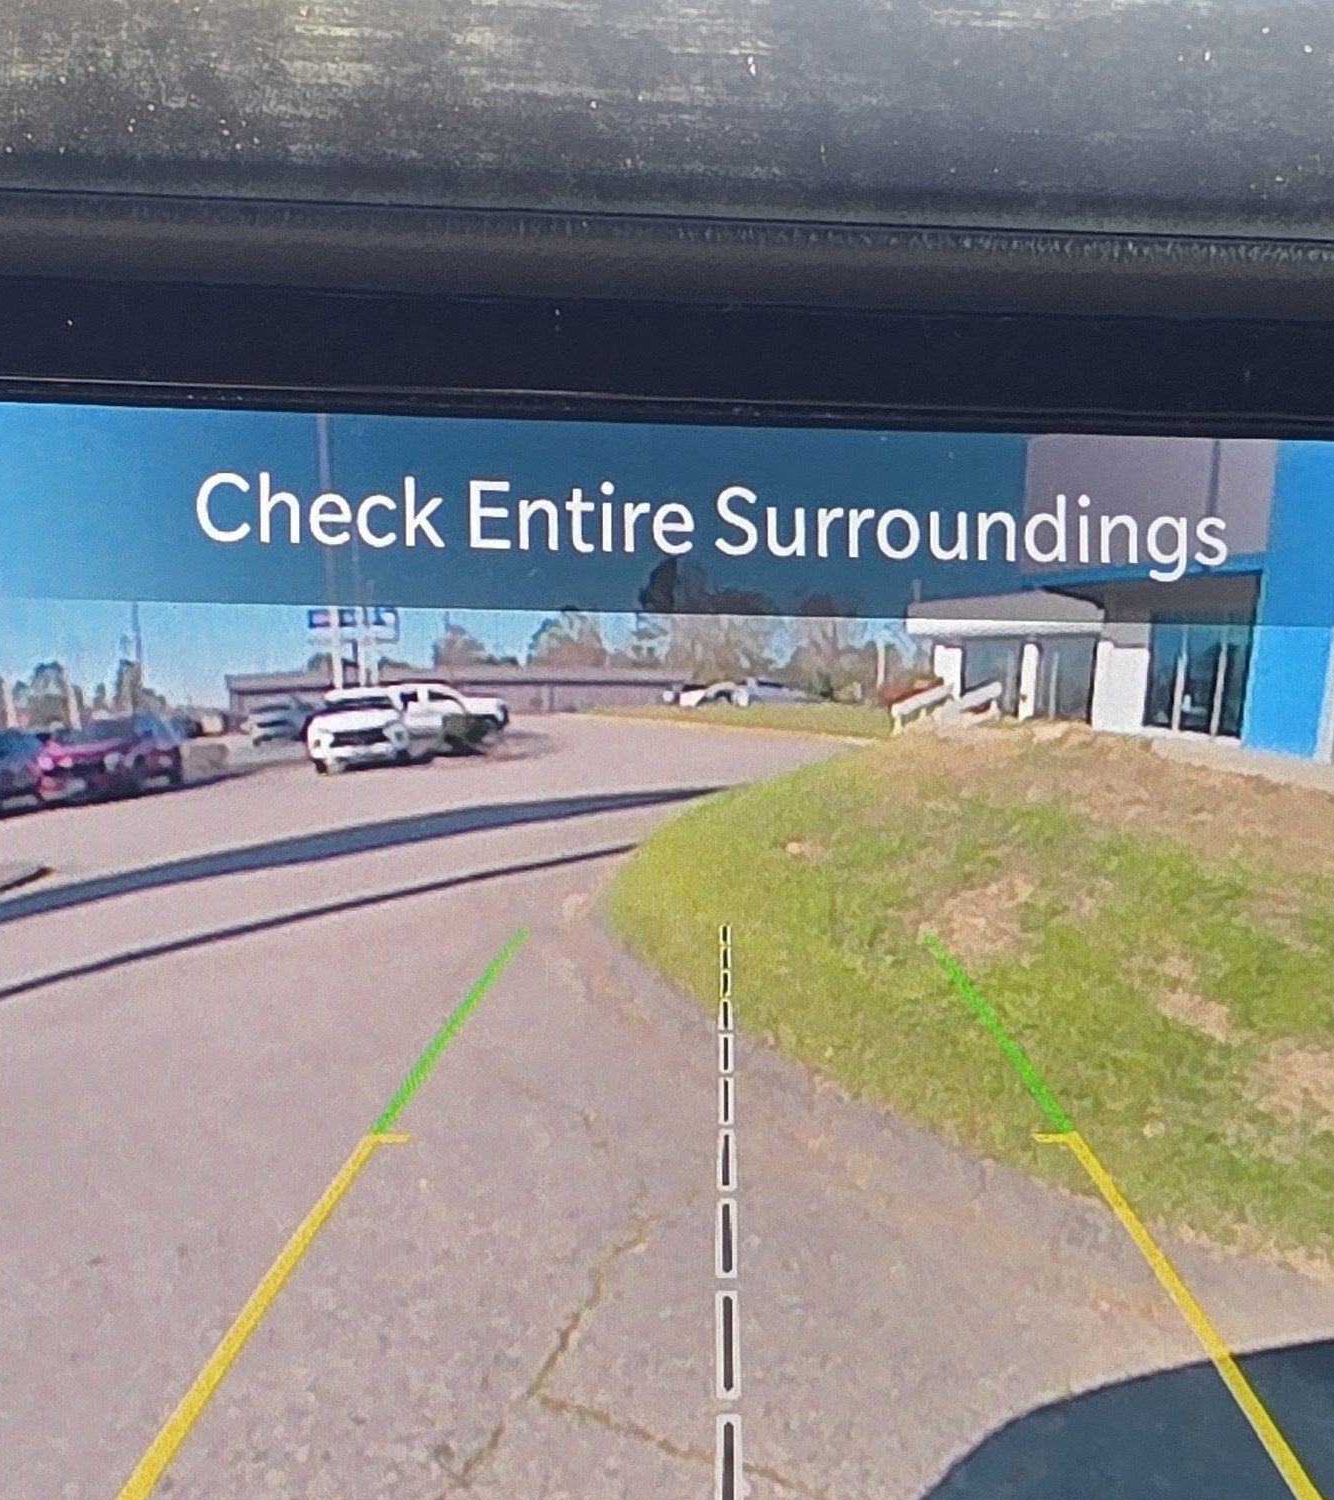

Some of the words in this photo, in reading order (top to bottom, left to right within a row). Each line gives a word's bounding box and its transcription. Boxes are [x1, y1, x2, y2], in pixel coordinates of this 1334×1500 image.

[197, 472, 445, 547] Check
[470, 481, 695, 555] Entire
[716, 487, 1229, 582] Surroundings
